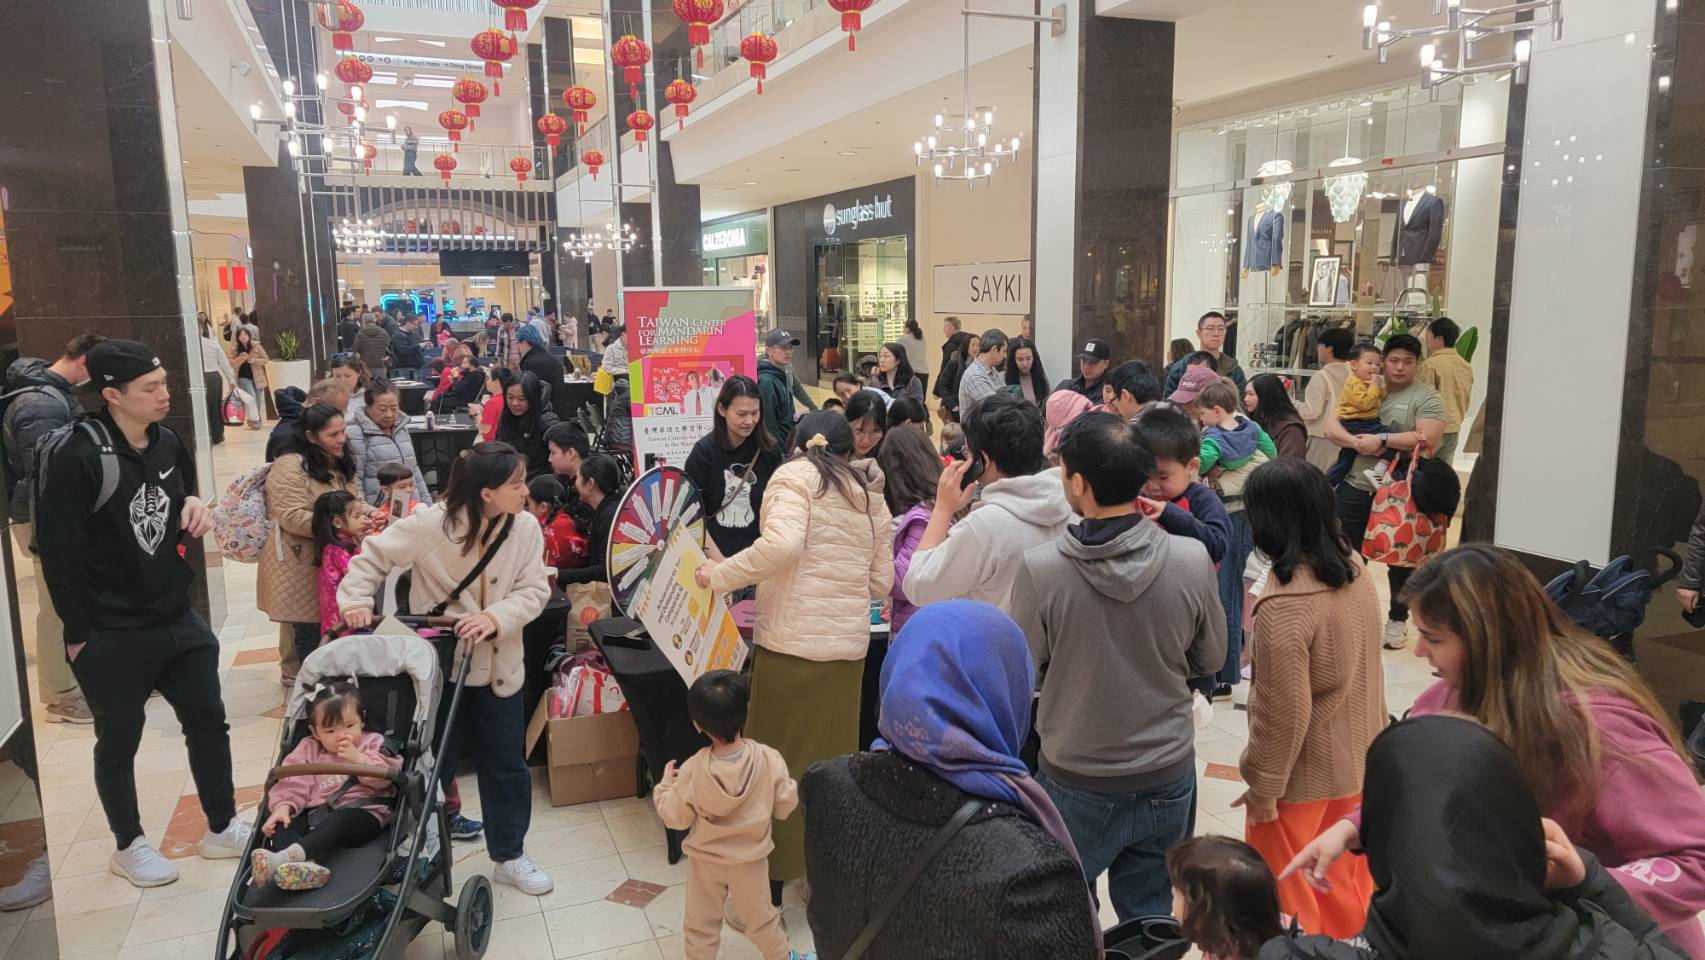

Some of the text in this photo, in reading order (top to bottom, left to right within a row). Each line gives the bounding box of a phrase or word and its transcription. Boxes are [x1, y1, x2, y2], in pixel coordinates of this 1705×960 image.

[835, 193, 893, 230] sunglass hut
[702, 227, 746, 252] CALZEDONIA
[970, 273, 1022, 303] SAYKI
[637, 316, 727, 328] TAIWAN CENTER
[639, 335, 699, 346] LEARNING
[658, 326, 723, 337] MANDARIN
